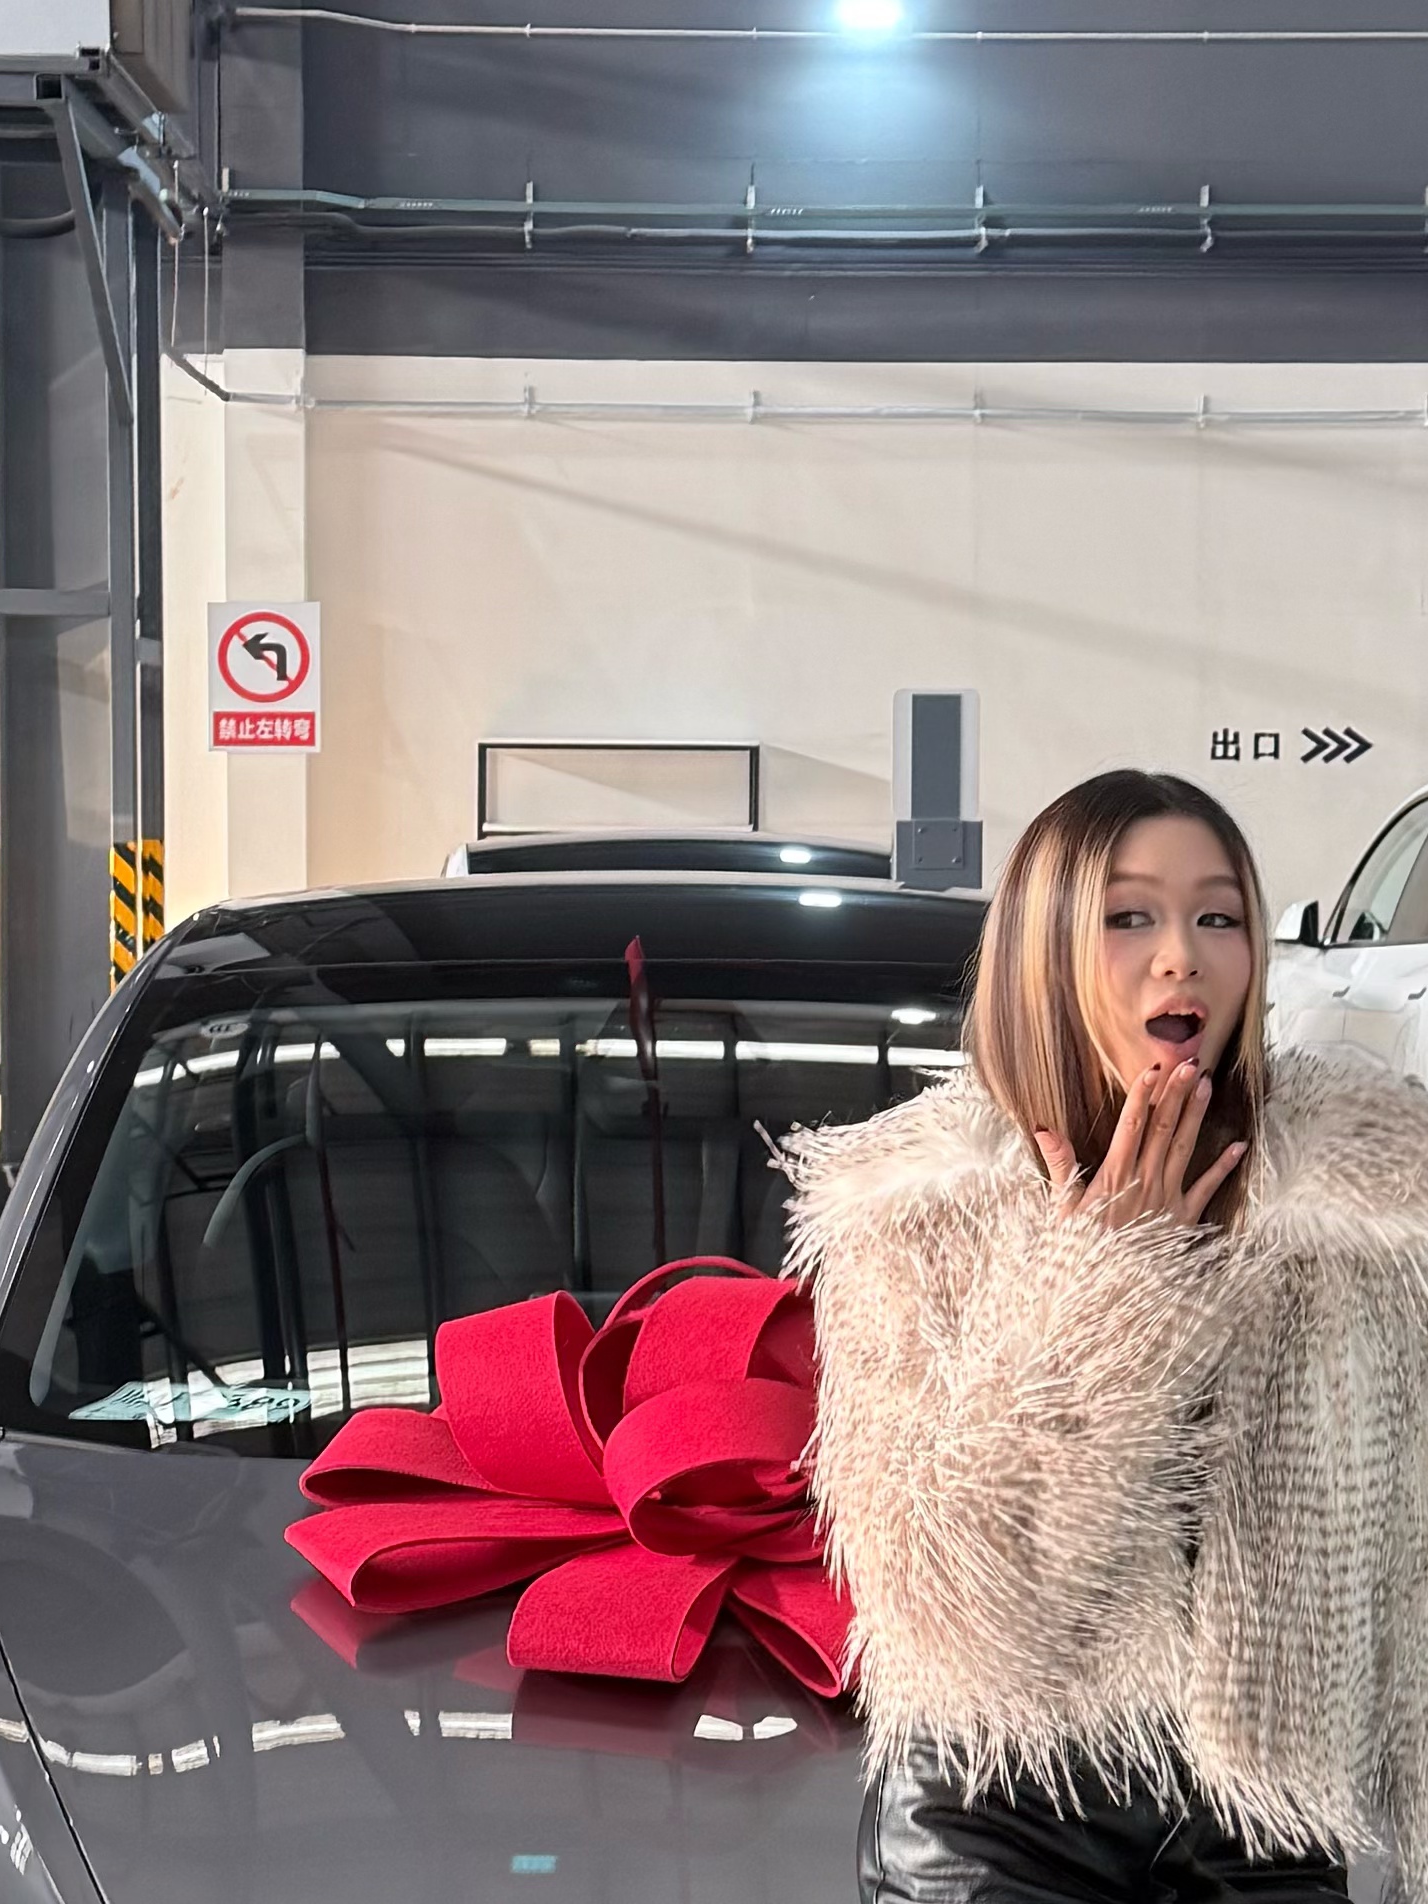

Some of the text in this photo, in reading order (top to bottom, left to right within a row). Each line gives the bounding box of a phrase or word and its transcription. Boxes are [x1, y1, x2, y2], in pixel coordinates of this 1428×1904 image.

[218, 717, 311, 741] 禁止左转弯
[1210, 727, 1280, 761] 出口
